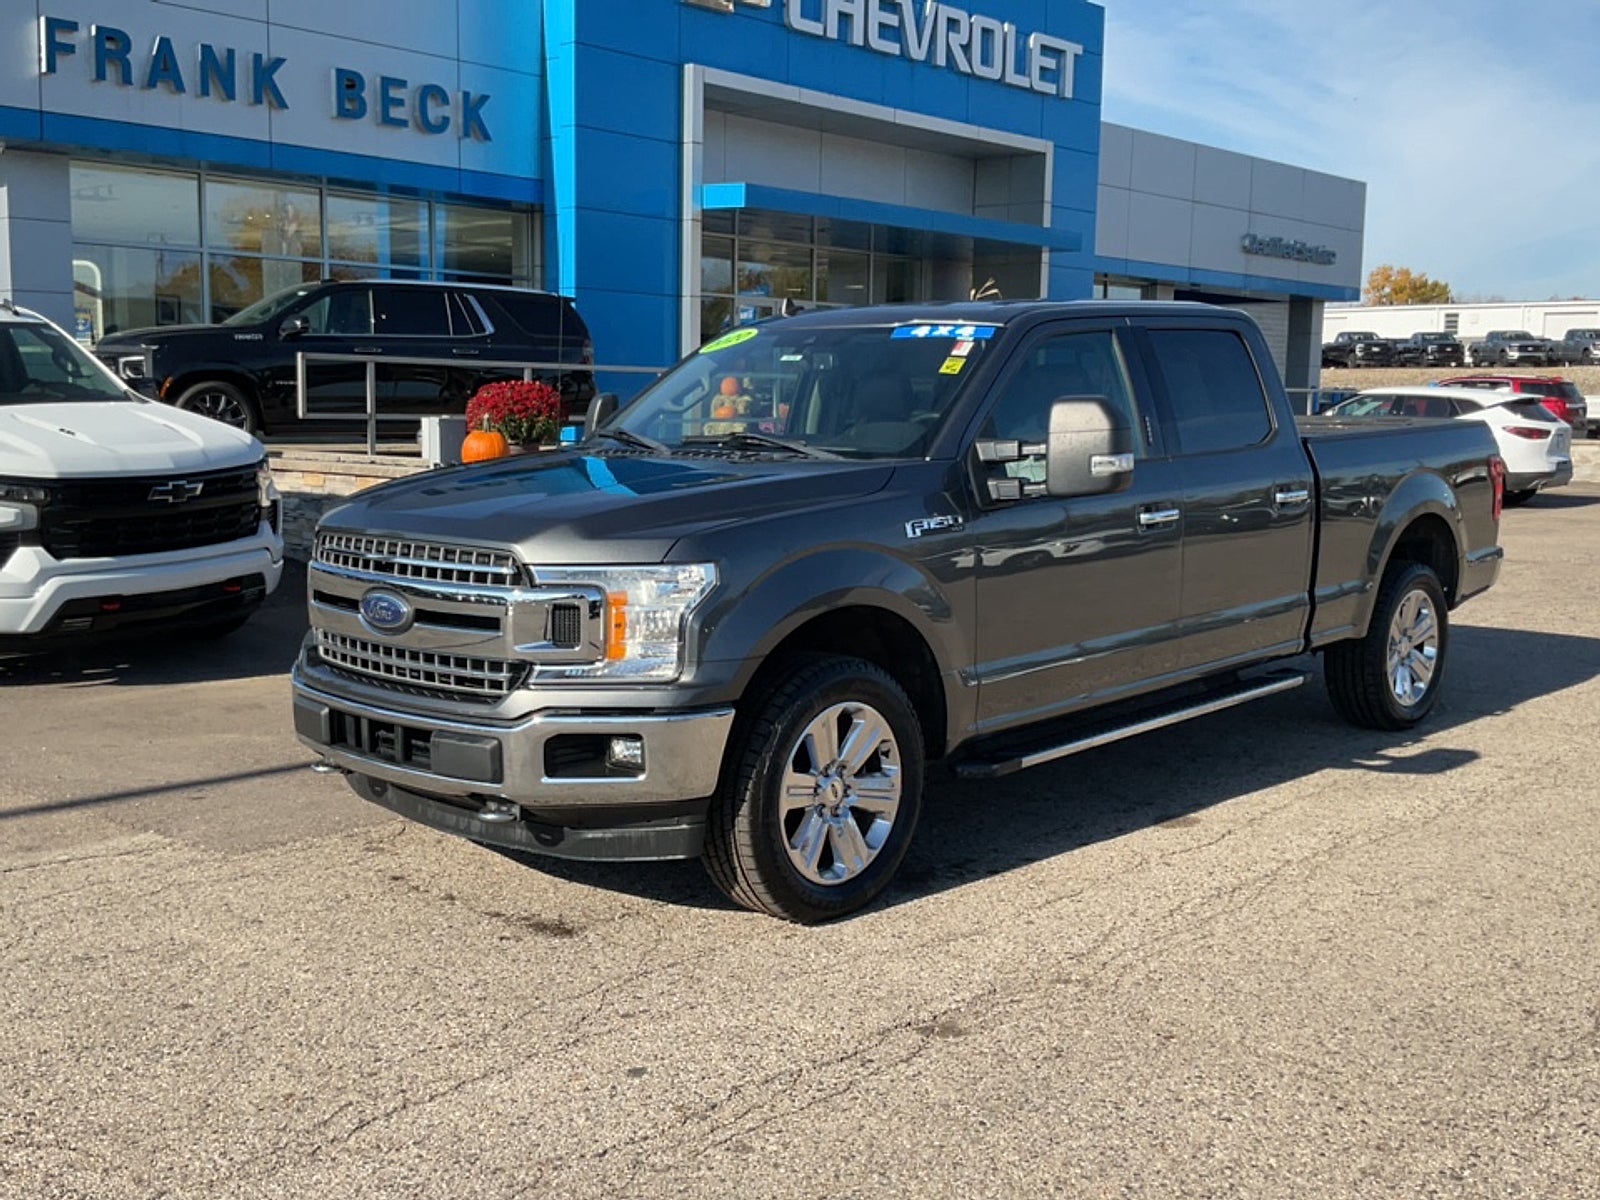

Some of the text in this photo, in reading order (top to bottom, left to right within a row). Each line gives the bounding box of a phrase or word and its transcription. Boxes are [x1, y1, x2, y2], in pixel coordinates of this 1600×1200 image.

[39, 16, 493, 141] FRANK BECK
[784, 0, 1083, 98] CHEVROLET
